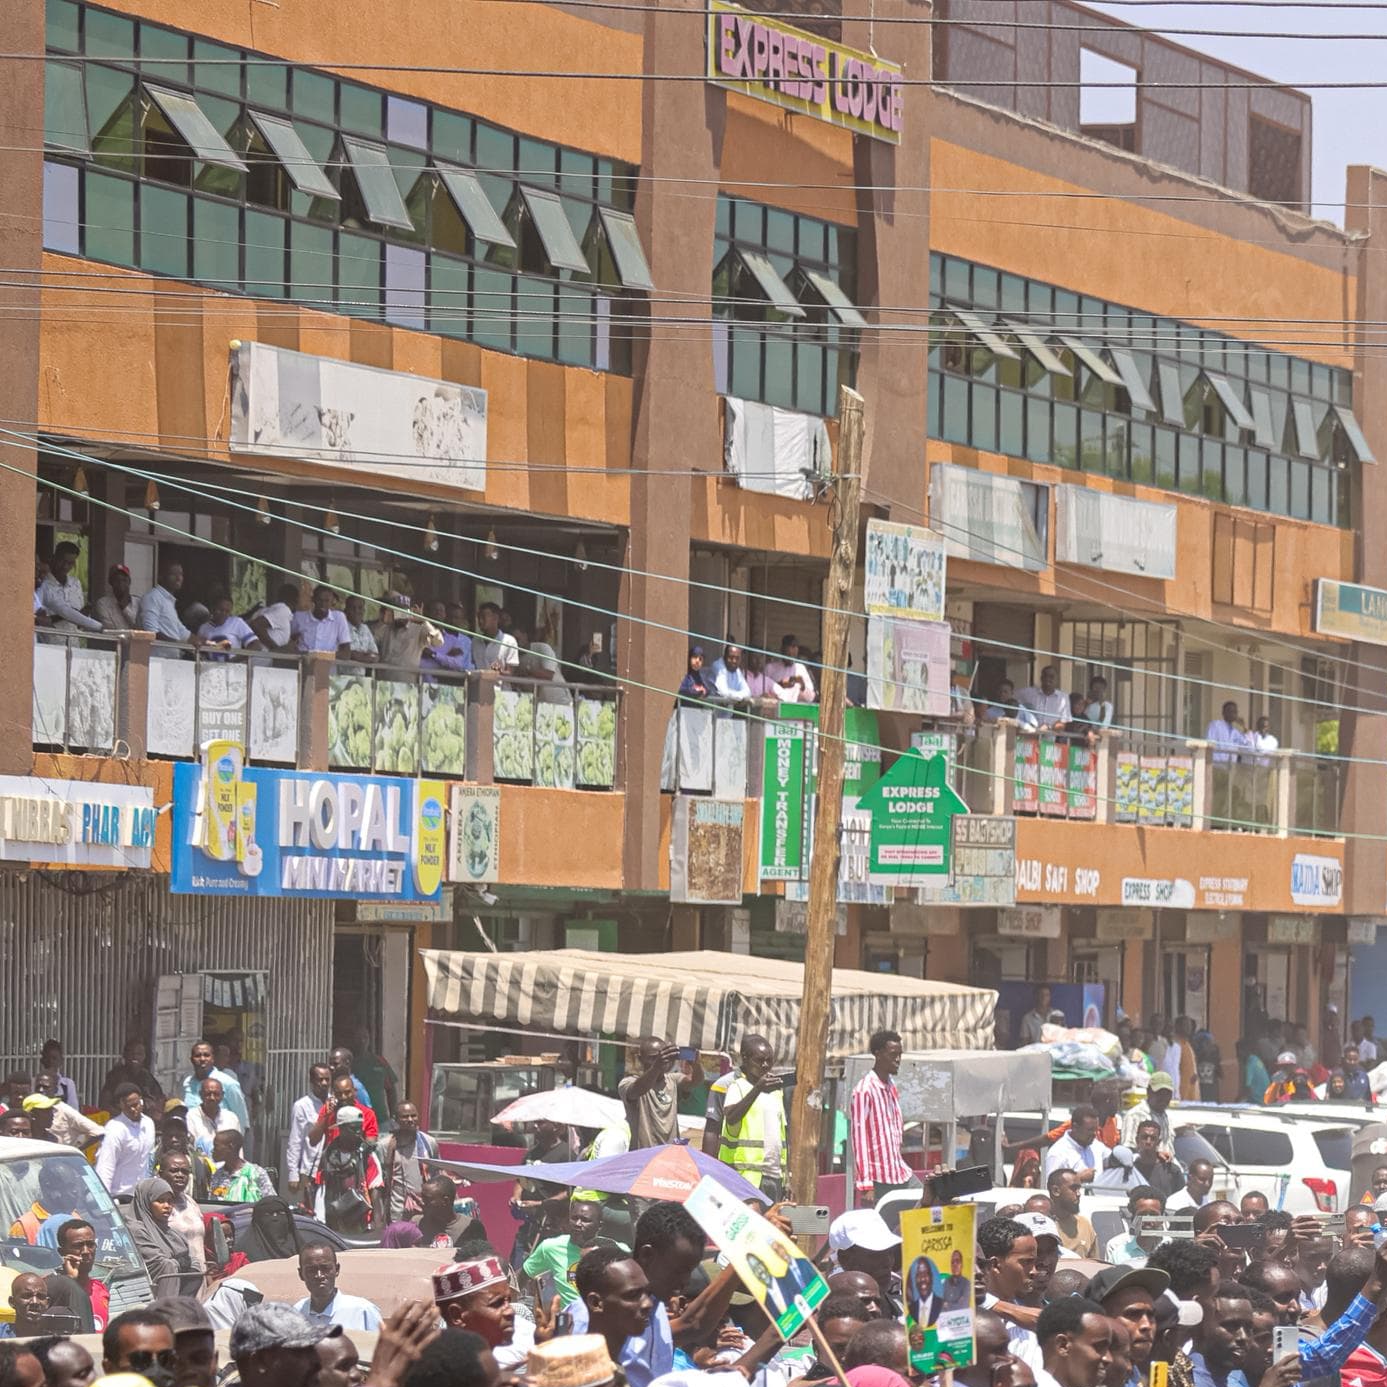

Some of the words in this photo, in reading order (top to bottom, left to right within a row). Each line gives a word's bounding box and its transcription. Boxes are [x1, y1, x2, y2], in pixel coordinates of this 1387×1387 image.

[720, 15, 826, 104] EXPRESS
[833, 51, 904, 131] LODGE
[202, 711, 221, 725] BUY
[223, 712, 242, 725] ONE
[202, 729, 220, 741] GET
[776, 738, 792, 788] MONEY
[882, 787, 940, 798] EXPRESS
[888, 802, 934, 813] LODGE
[279, 780, 410, 853] HOPAL
[282, 856, 327, 890] MINI
[328, 857, 406, 893] MARKET
[763, 867, 799, 878] AGENT
[1046, 863, 1067, 892] SAFI
[1075, 867, 1099, 896] SHOP
[1125, 882, 1150, 900] EXPRESS
[1155, 882, 1174, 900] SHOP
[921, 1236, 953, 1252] GARISSA
